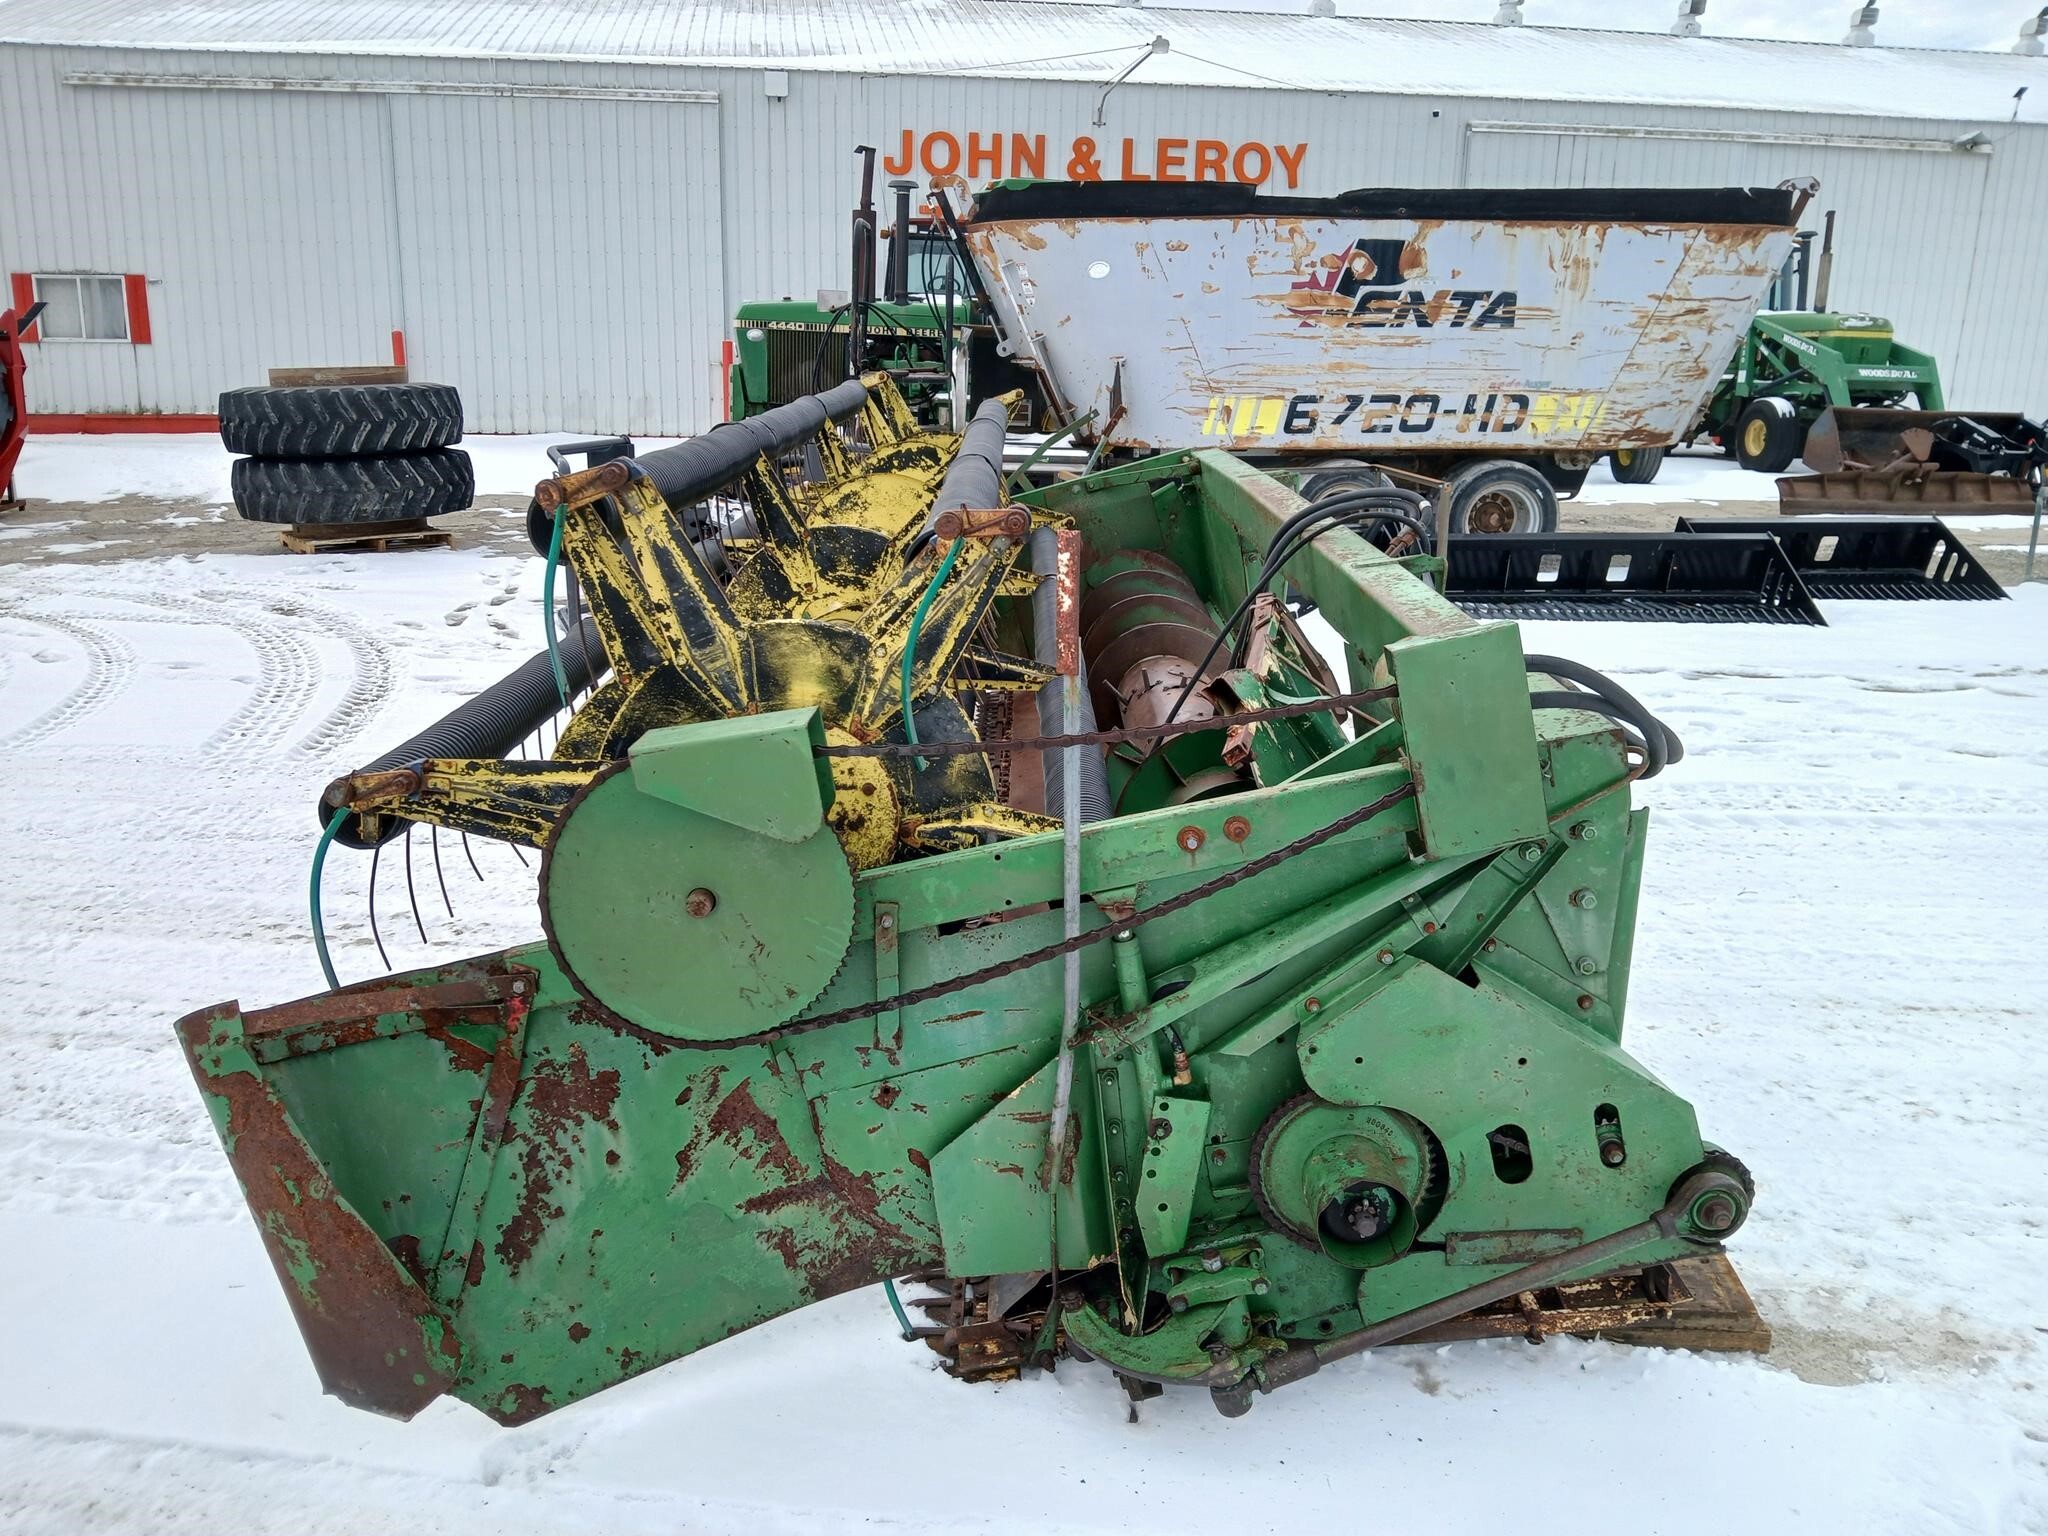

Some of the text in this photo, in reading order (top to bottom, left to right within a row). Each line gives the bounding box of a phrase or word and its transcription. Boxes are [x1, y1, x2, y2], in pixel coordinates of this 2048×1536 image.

[884, 129, 1309, 189] JOHN & LEROY
[768, 320, 805, 331] 4440
[867, 326, 945, 337] JOHN DEERE
[1858, 368, 1890, 378] WOODS
[1283, 394, 1530, 434] 6720-HD
